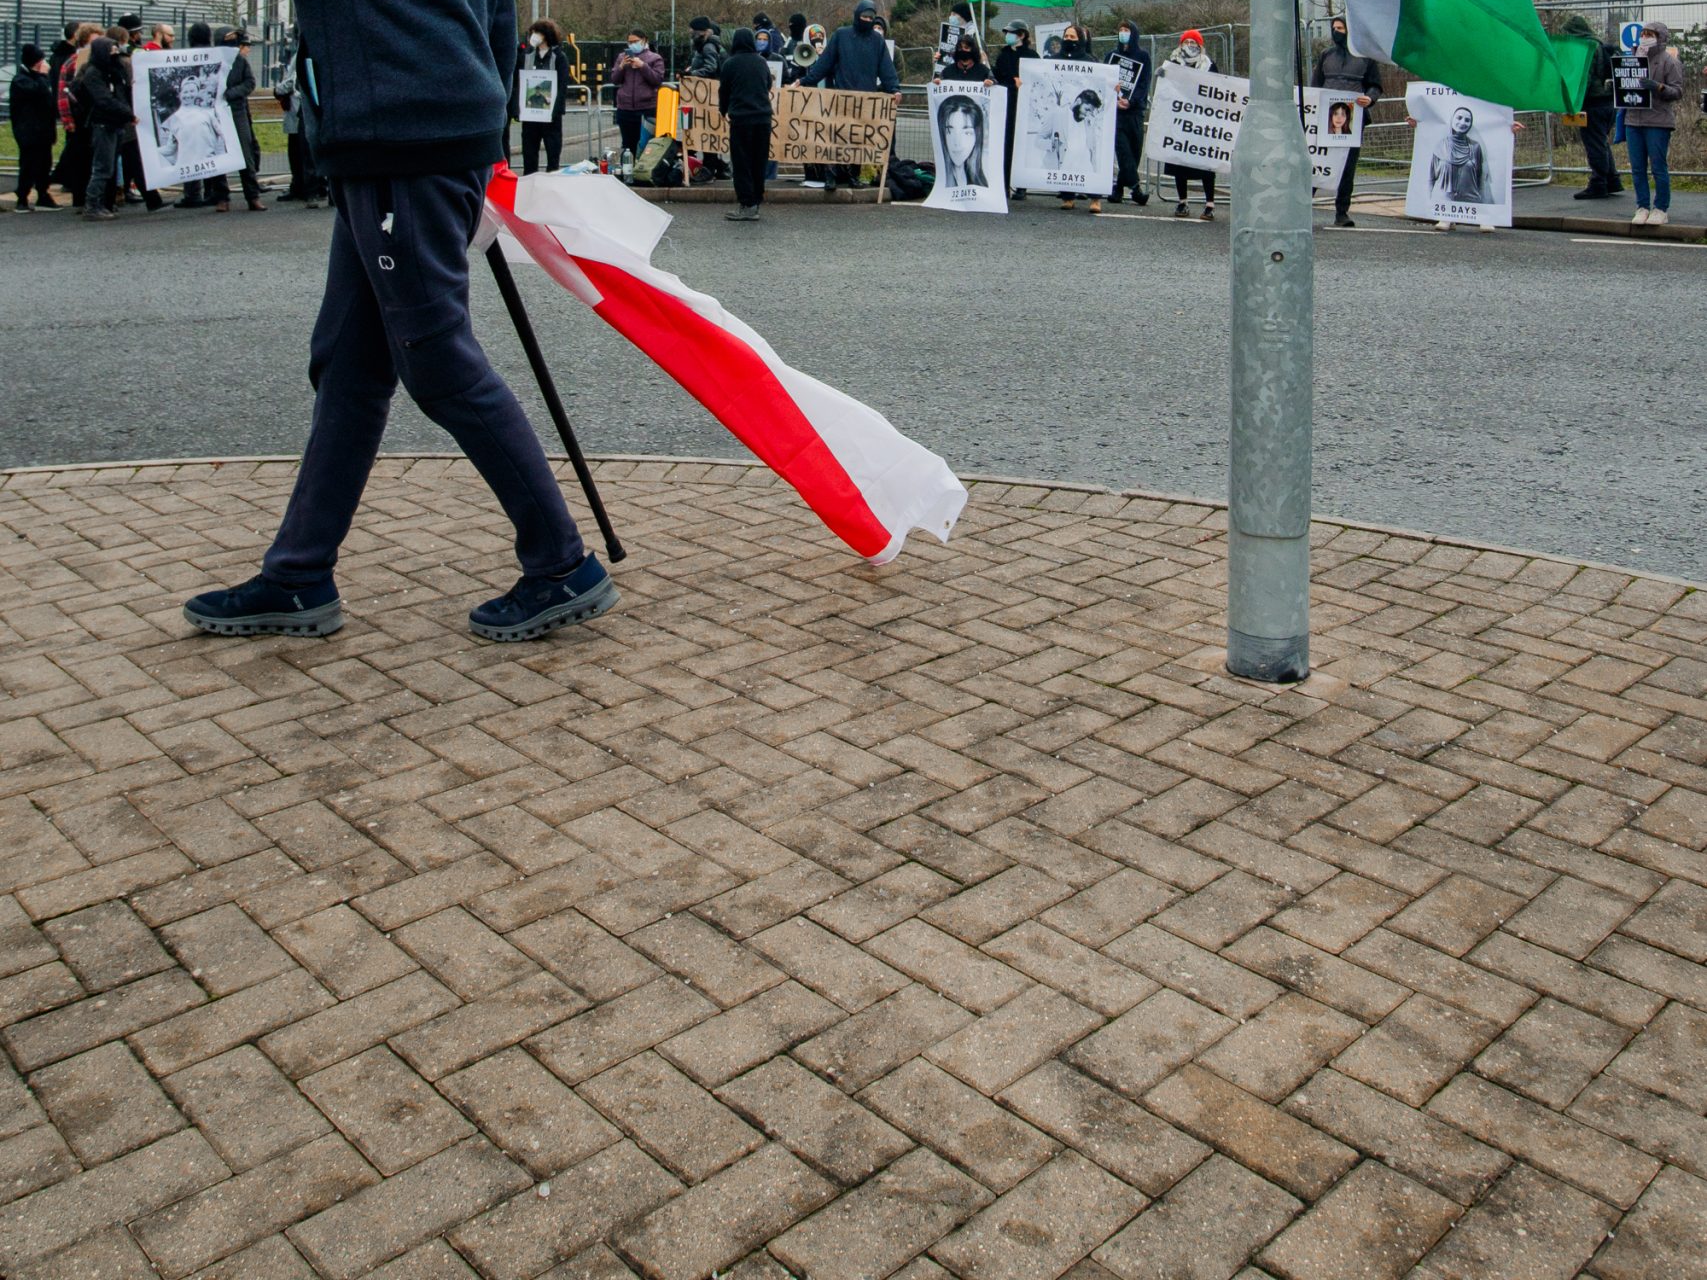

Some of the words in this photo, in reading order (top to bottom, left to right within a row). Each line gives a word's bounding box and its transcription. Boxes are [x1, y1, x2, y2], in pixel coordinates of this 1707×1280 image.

[166, 55, 188, 63] AMU
[193, 53, 209, 62] GIB
[1054, 63, 1093, 74] KAMRAN
[1615, 67, 1630, 78] SHUT
[1631, 67, 1648, 78] ELBIT
[1620, 77, 1641, 88] DOWN
[933, 85, 954, 95] HEBA
[1197, 84, 1238, 104] Elbit
[1425, 87, 1458, 96] TEUTA
[819, 93, 863, 120] WITH
[867, 96, 898, 122] THE
[1171, 100, 1244, 123] genocid
[788, 118, 890, 151] STRIKERS
[784, 143, 808, 160] FOR
[814, 145, 883, 164] PALESTINE
[180, 166, 190, 176] 33
[194, 160, 217, 173] DAYS
[1047, 172, 1058, 181] 25
[1061, 173, 1086, 183] DAYS
[961, 189, 977, 198] DAYS
[1434, 203, 1447, 212] 26
[1451, 205, 1477, 216] DAYS
